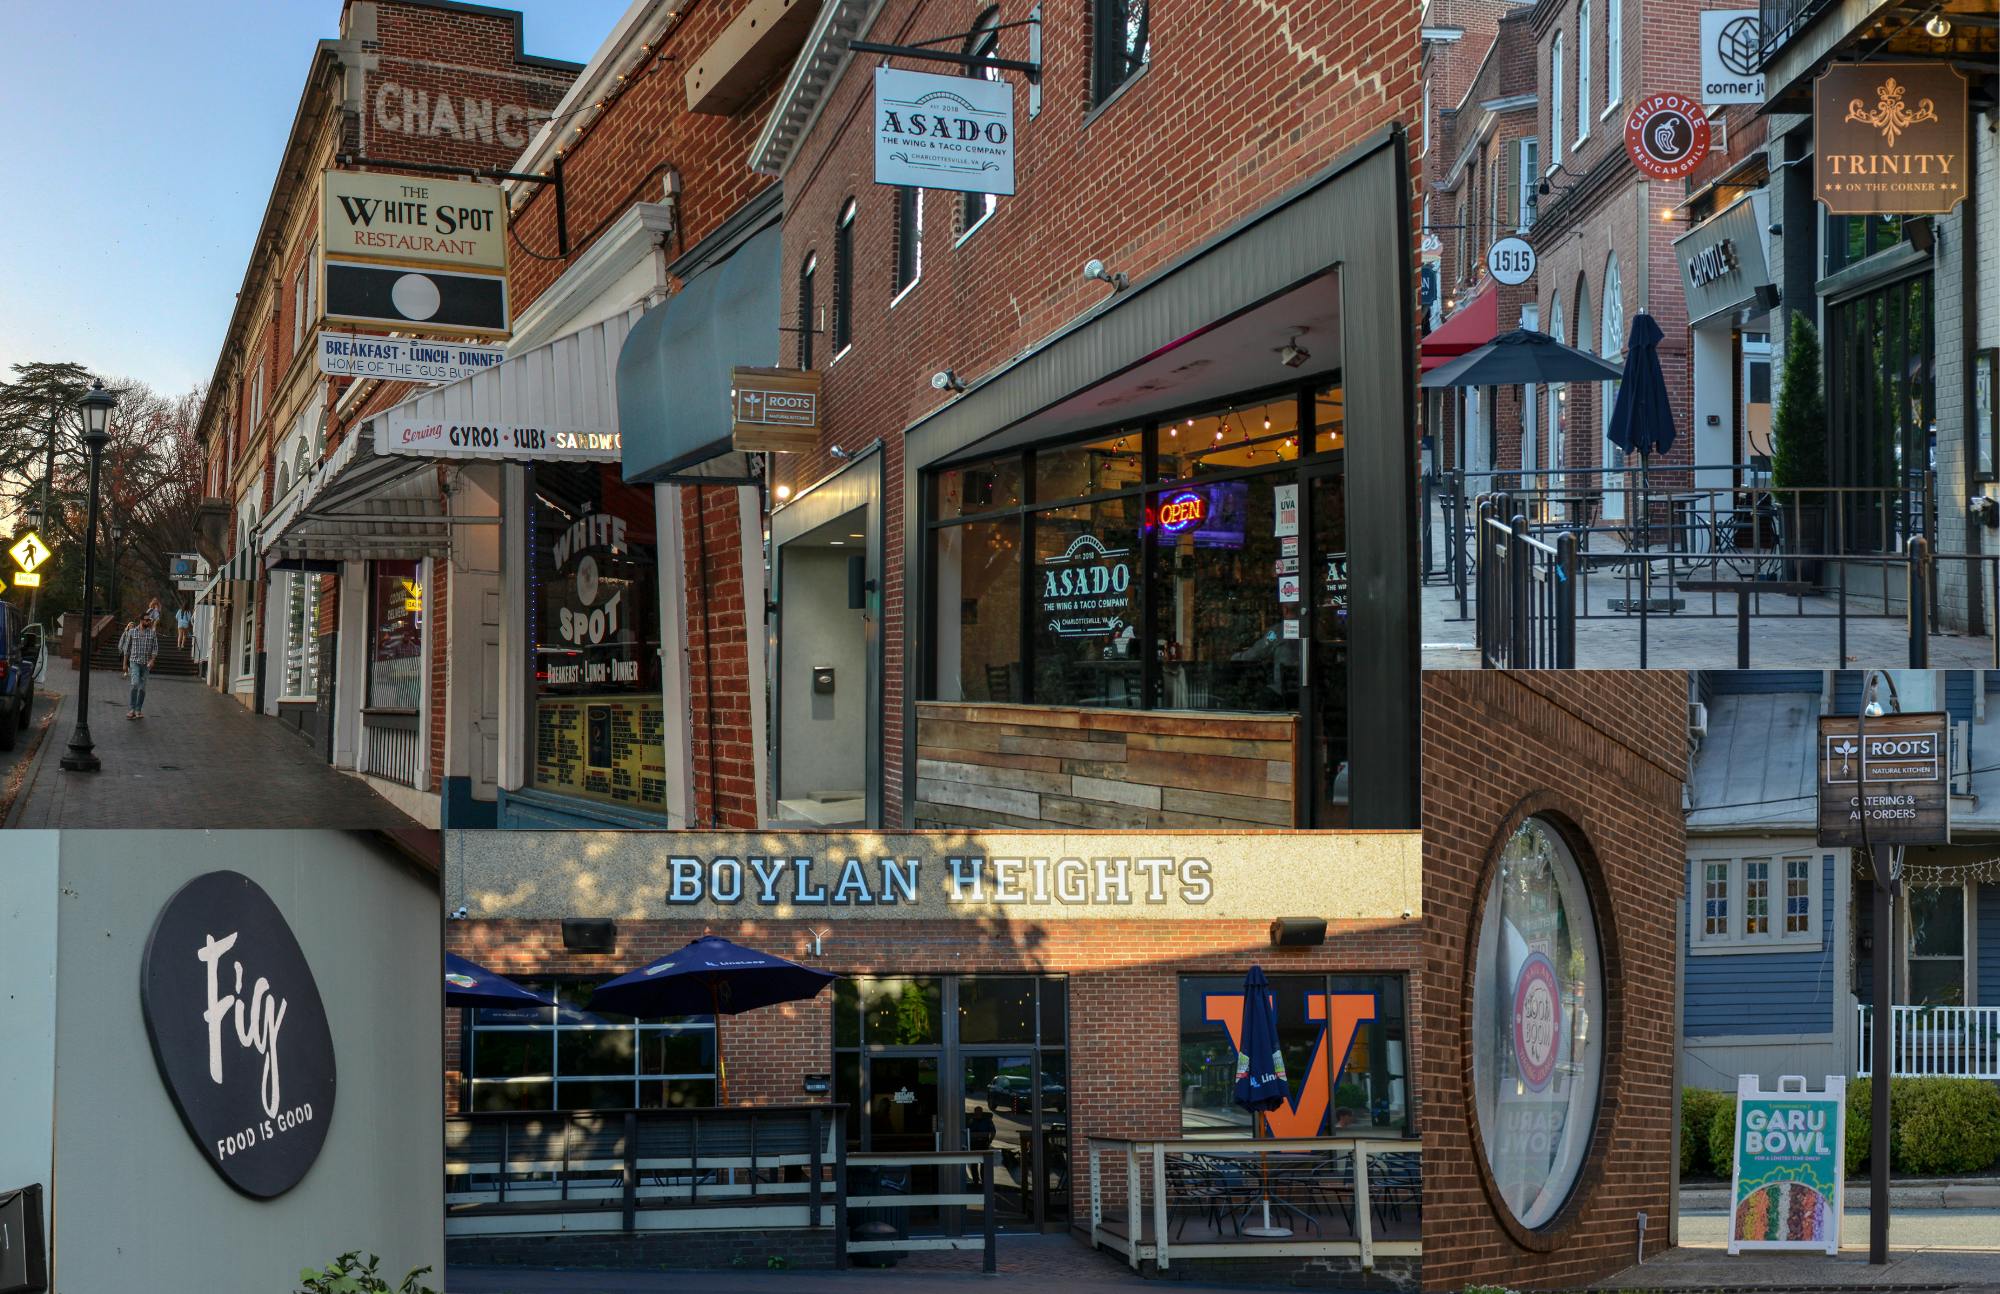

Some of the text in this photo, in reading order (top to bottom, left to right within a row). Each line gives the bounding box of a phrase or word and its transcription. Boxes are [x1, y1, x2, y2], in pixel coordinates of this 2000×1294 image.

[1706, 82, 1753, 94] corner
[942, 105, 959, 113] 2018
[1631, 96, 1706, 130] CHIPOTLE
[882, 110, 1008, 144] ASADO
[882, 137, 899, 145] THE
[902, 138, 927, 148] WING
[938, 142, 962, 152] TACO
[966, 145, 1007, 156] COMPANY
[1634, 144, 1705, 175] MEXICAN GRILL
[1826, 154, 1955, 175] TRINITY
[400, 186, 429, 200] THE
[1846, 183, 1935, 192] ON THE CORNER
[337, 195, 494, 235] WHITE SPOT
[354, 230, 476, 256] RESTAURANT
[1688, 240, 1730, 288] CHIPOTLE
[326, 340, 399, 360] BREAKFAST
[410, 348, 449, 364] LUNCH
[327, 358, 364, 372] HOME
[368, 362, 384, 373] OF
[388, 362, 413, 375] THE
[769, 396, 810, 409] ROOTS
[402, 424, 443, 444] Serving
[450, 426, 499, 448] GYROS
[514, 428, 547, 449] SUBS
[1160, 499, 1201, 525] OPEN
[1280, 501, 1296, 510] UVA
[554, 513, 629, 571] WHITE
[1082, 552, 1095, 560] 2018
[1044, 564, 1130, 598] ASADO
[1044, 598, 1129, 611] THE WING & TACO COMPANY
[560, 590, 621, 646] SPOT
[548, 658, 639, 684] BREAKFAST LUNCH DINNER
[1872, 740, 1930, 755] ROOTS
[1906, 796, 1915, 805] &
[1872, 808, 1916, 820] ORDERS
[666, 856, 1213, 905] BOYLAN HEIGHTS
[198, 932, 288, 1119] Fig
[1526, 1020, 1551, 1047] BOOM
[218, 1103, 313, 1161] FOOD IS GOOD
[1746, 1110, 1826, 1131] GARU
[1745, 1132, 1831, 1155] BOWL
